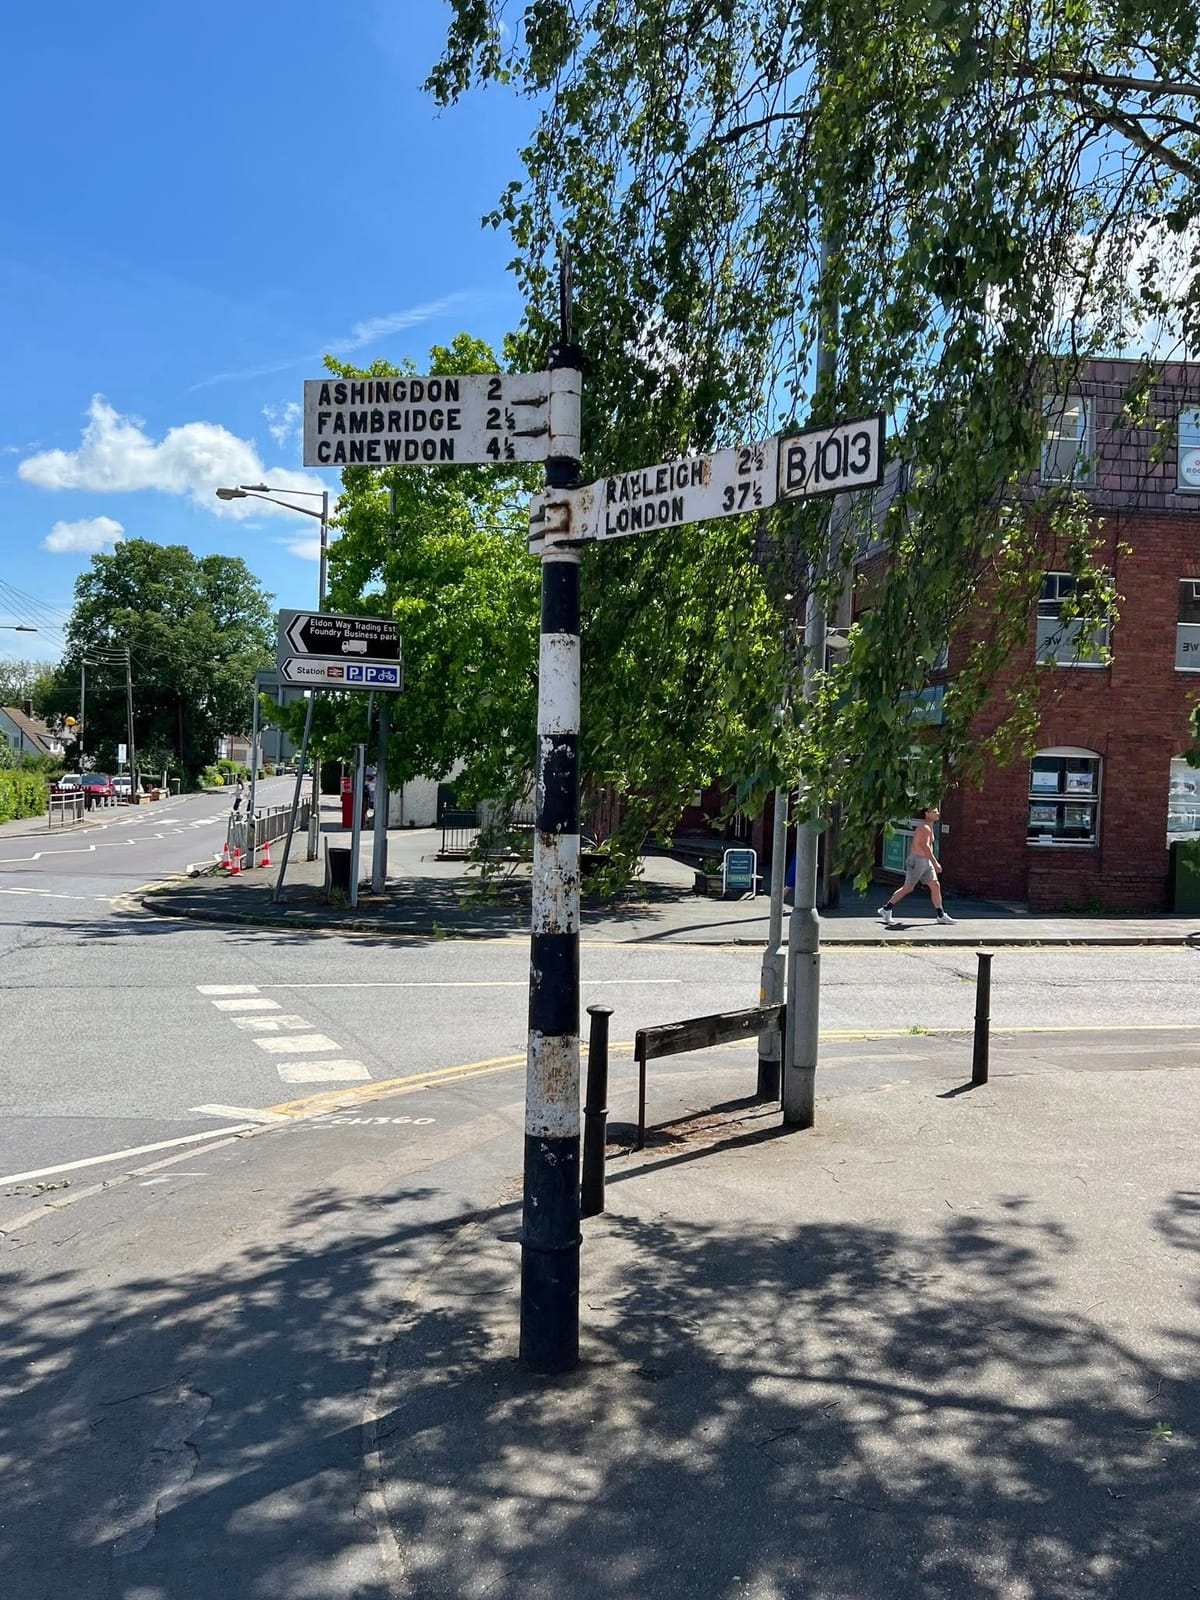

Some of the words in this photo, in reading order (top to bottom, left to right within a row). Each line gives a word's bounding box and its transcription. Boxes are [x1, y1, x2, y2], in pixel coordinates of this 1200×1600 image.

[318, 379, 460, 406] ASHINGDON
[487, 378, 502, 401] 2
[317, 408, 462, 435] FAMBRIDGE
[317, 438, 455, 463] CANEWDON
[787, 431, 871, 490] B1013
[606, 460, 704, 505] RAYLEIGH
[605, 496, 684, 535] LONDON
[310, 619, 333, 628] Eldon
[335, 620, 351, 630] Way
[354, 622, 381, 632] Trading
[383, 624, 396, 632] Est
[310, 627, 341, 638] Foundry
[344, 630, 377, 639] Business
[380, 633, 398, 641] park
[297, 666, 325, 676] Station
[367, 668, 377, 680] P
